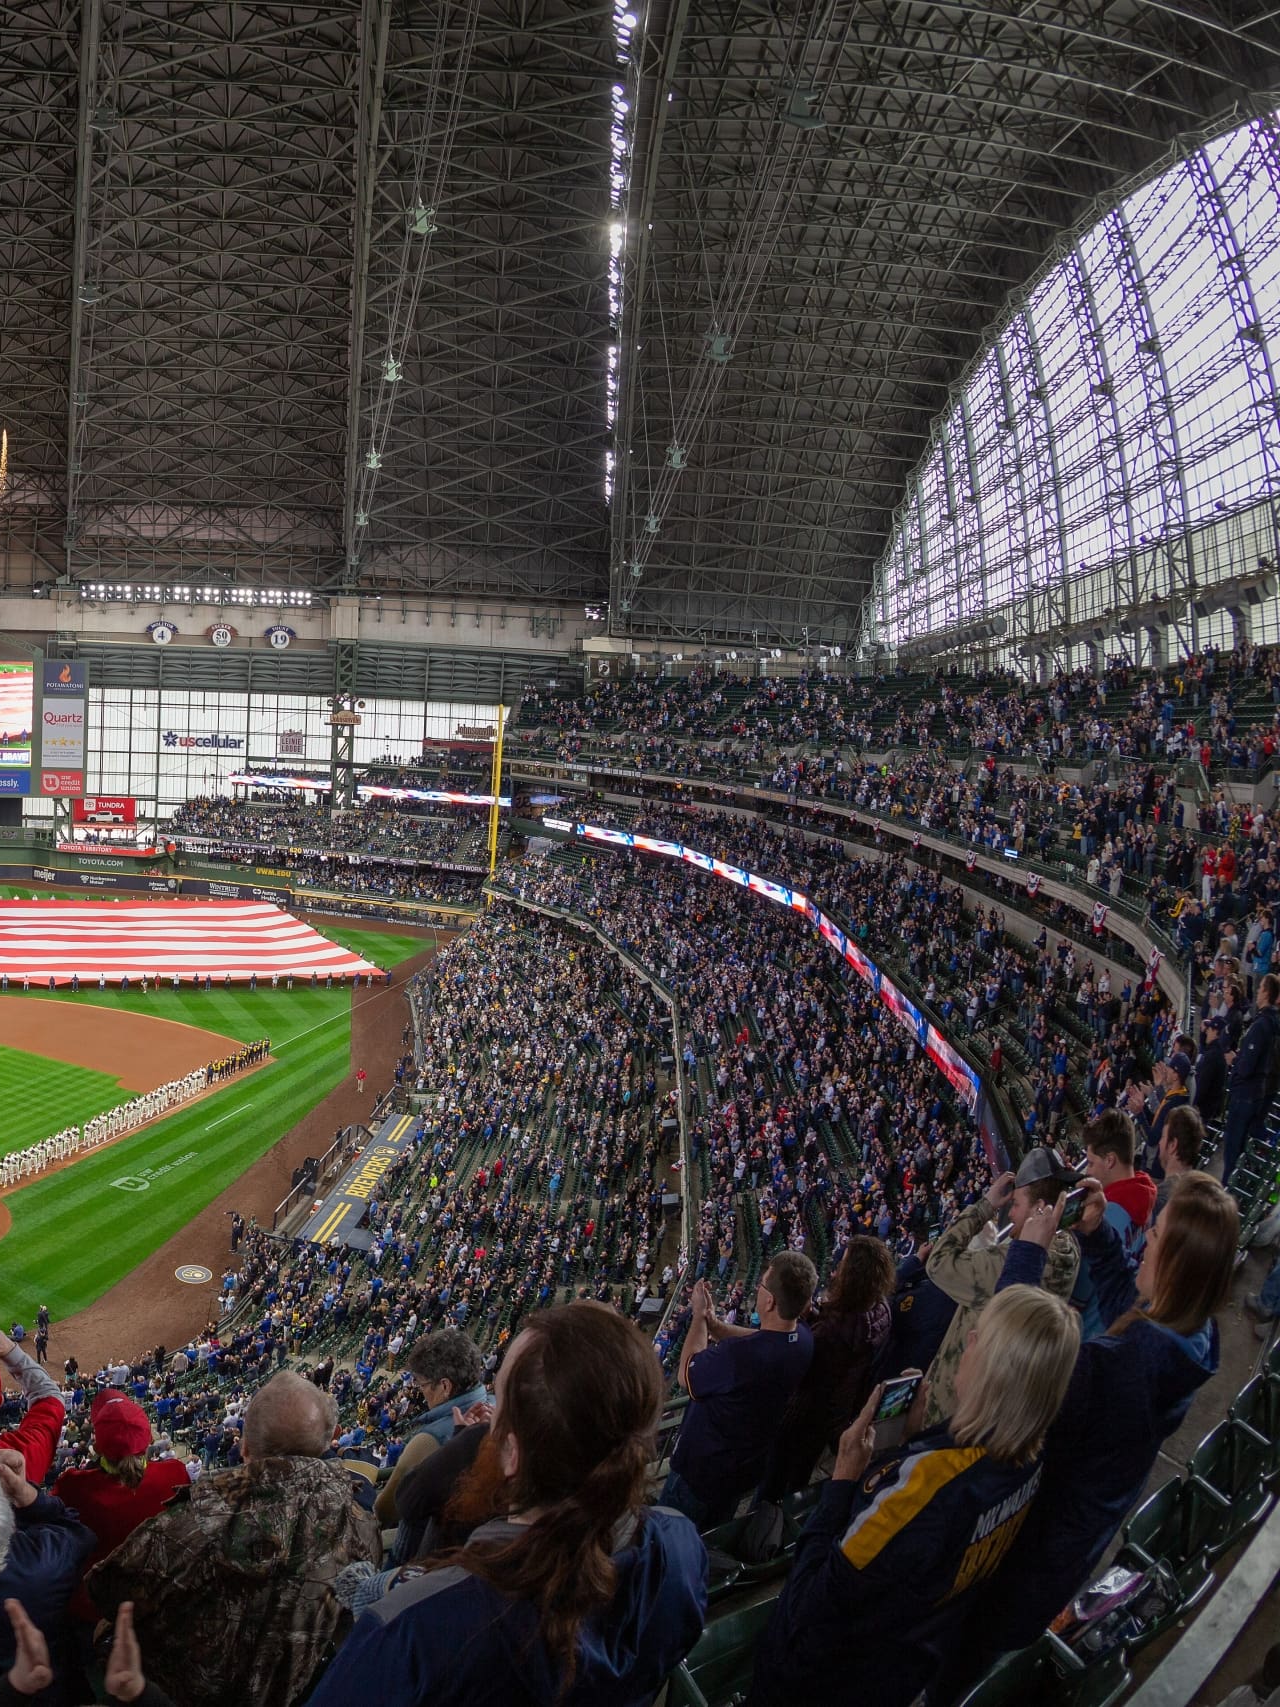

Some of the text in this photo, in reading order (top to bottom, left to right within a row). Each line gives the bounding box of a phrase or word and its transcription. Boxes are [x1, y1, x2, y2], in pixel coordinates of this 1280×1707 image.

[157, 630, 165, 640] 4
[216, 630, 228, 639] 50
[273, 635, 287, 645] 19
[44, 712, 83, 725] Quartz
[281, 744, 302, 753] LODGE
[2, 752, 29, 761] BRAVE!
[60, 844, 113, 853] TOYOTA TERRITORY
[78, 858, 124, 867] TOYOTA.COM
[255, 867, 291, 878] UWM.EDU
[454, 864, 483, 873] NETWORK
[33, 868, 56, 882] meijer
[171, 1151, 199, 1166] union
[344, 1155, 392, 1199] BREWERS
